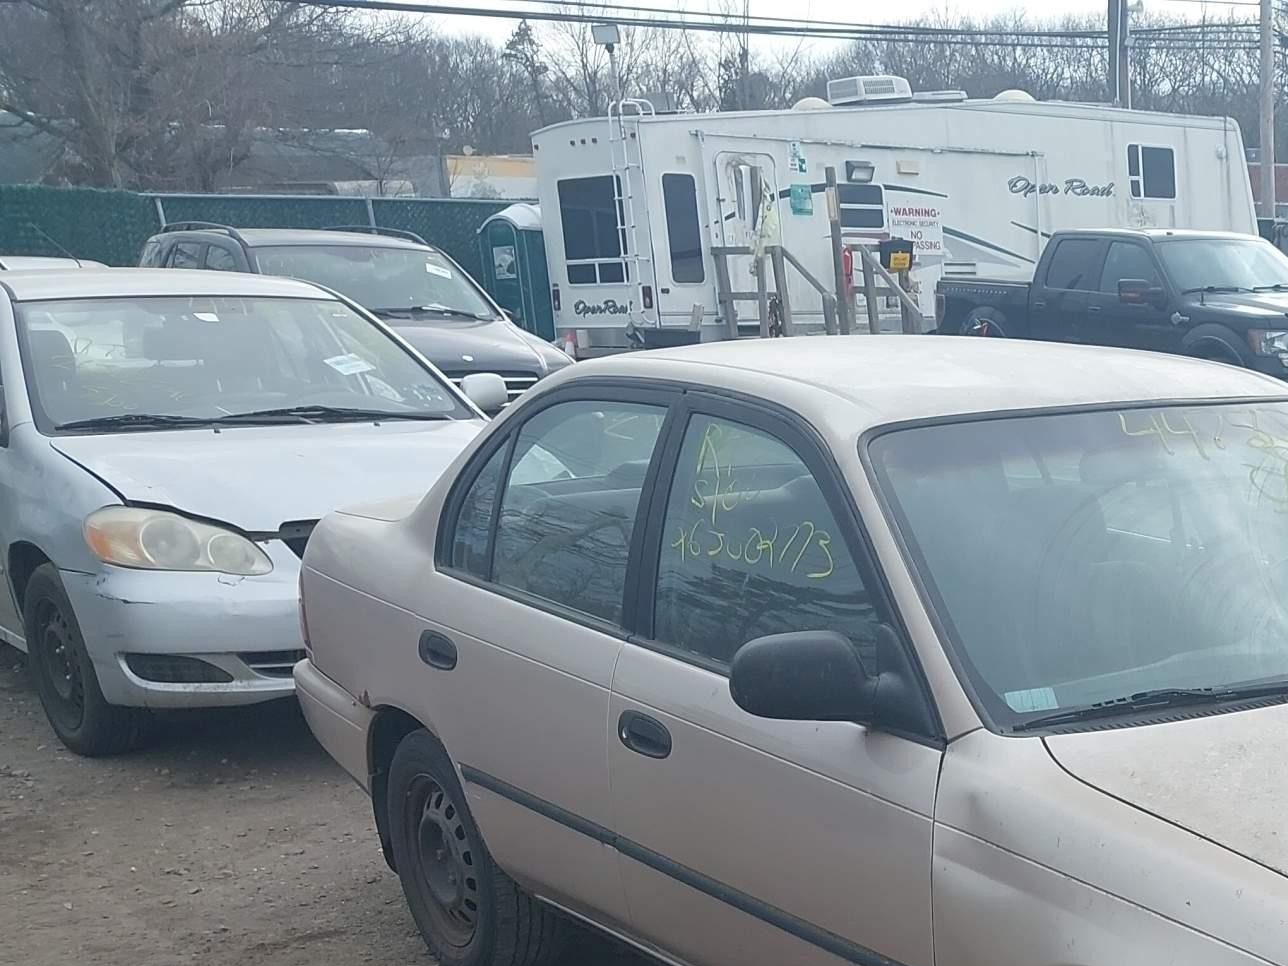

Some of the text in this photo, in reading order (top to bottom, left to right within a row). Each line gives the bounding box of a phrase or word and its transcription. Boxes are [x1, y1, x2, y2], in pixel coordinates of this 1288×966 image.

[1008, 175, 1116, 198] Open Road
[893, 207, 937, 217] WARNING
[911, 230, 923, 240] NO
[913, 241, 942, 250] PASSING
